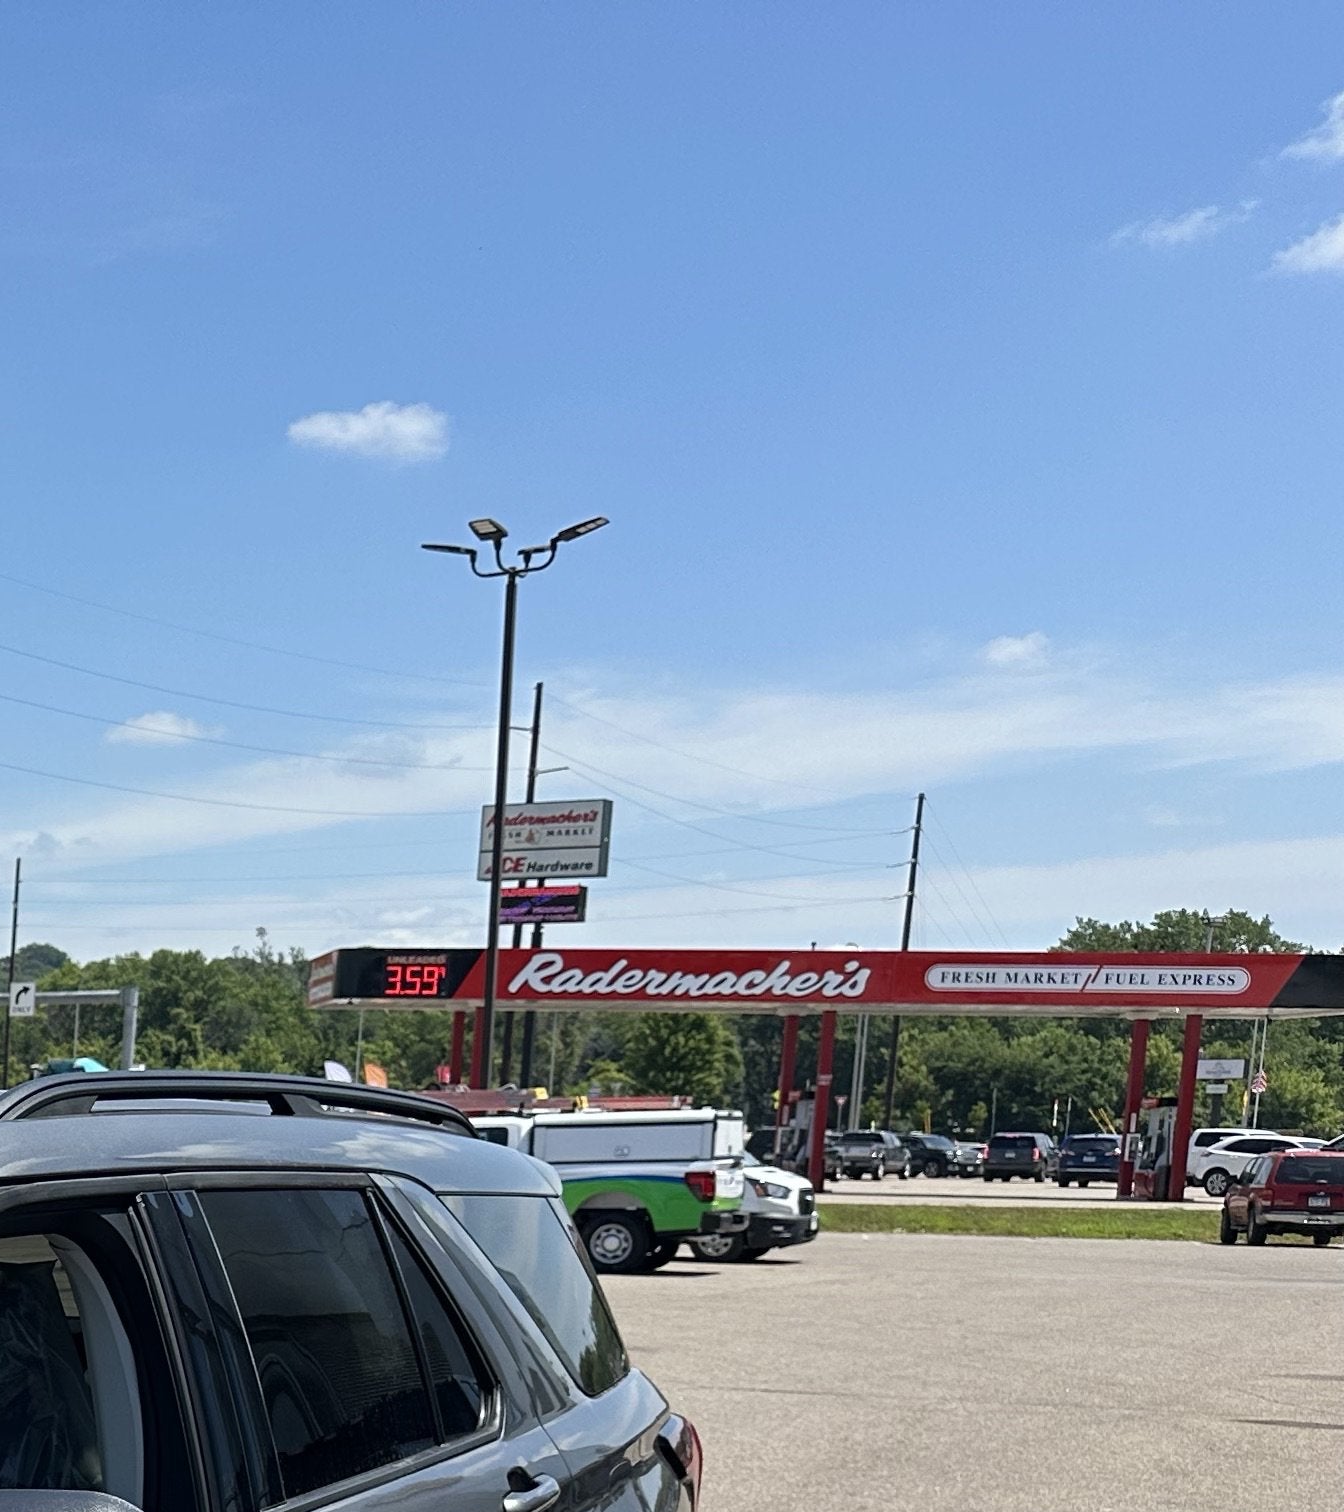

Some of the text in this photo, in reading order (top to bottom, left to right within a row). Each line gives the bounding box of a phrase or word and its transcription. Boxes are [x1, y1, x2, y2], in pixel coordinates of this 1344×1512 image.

[526, 860, 593, 873] Hardware
[508, 953, 872, 998] Radermacher's
[940, 971, 1237, 987] FRESH MARKET FUEL EXPRESS
